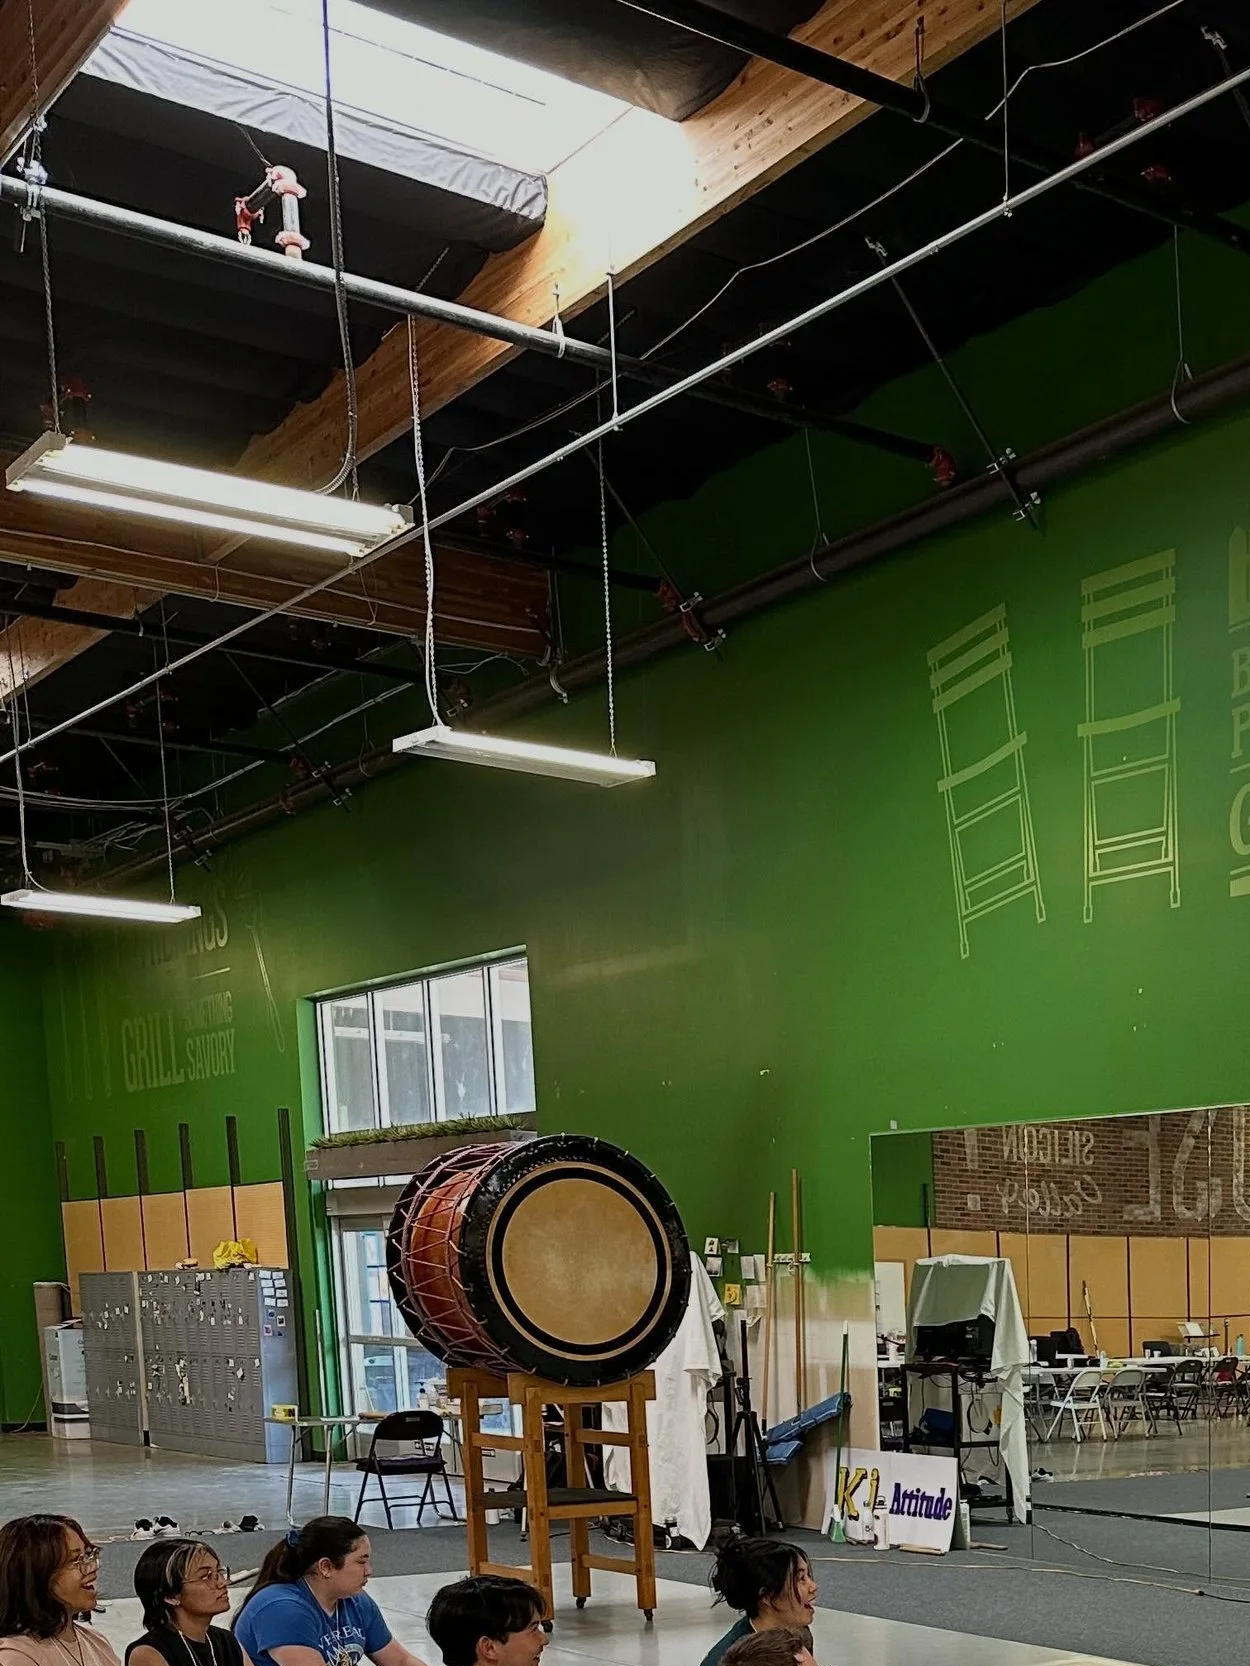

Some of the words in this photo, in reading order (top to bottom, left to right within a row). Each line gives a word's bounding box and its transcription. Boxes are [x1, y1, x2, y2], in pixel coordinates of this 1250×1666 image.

[121, 1009, 184, 1093] GRILL
[186, 1028, 235, 1081] SAVORY
[889, 1482, 952, 1520] Attitude
